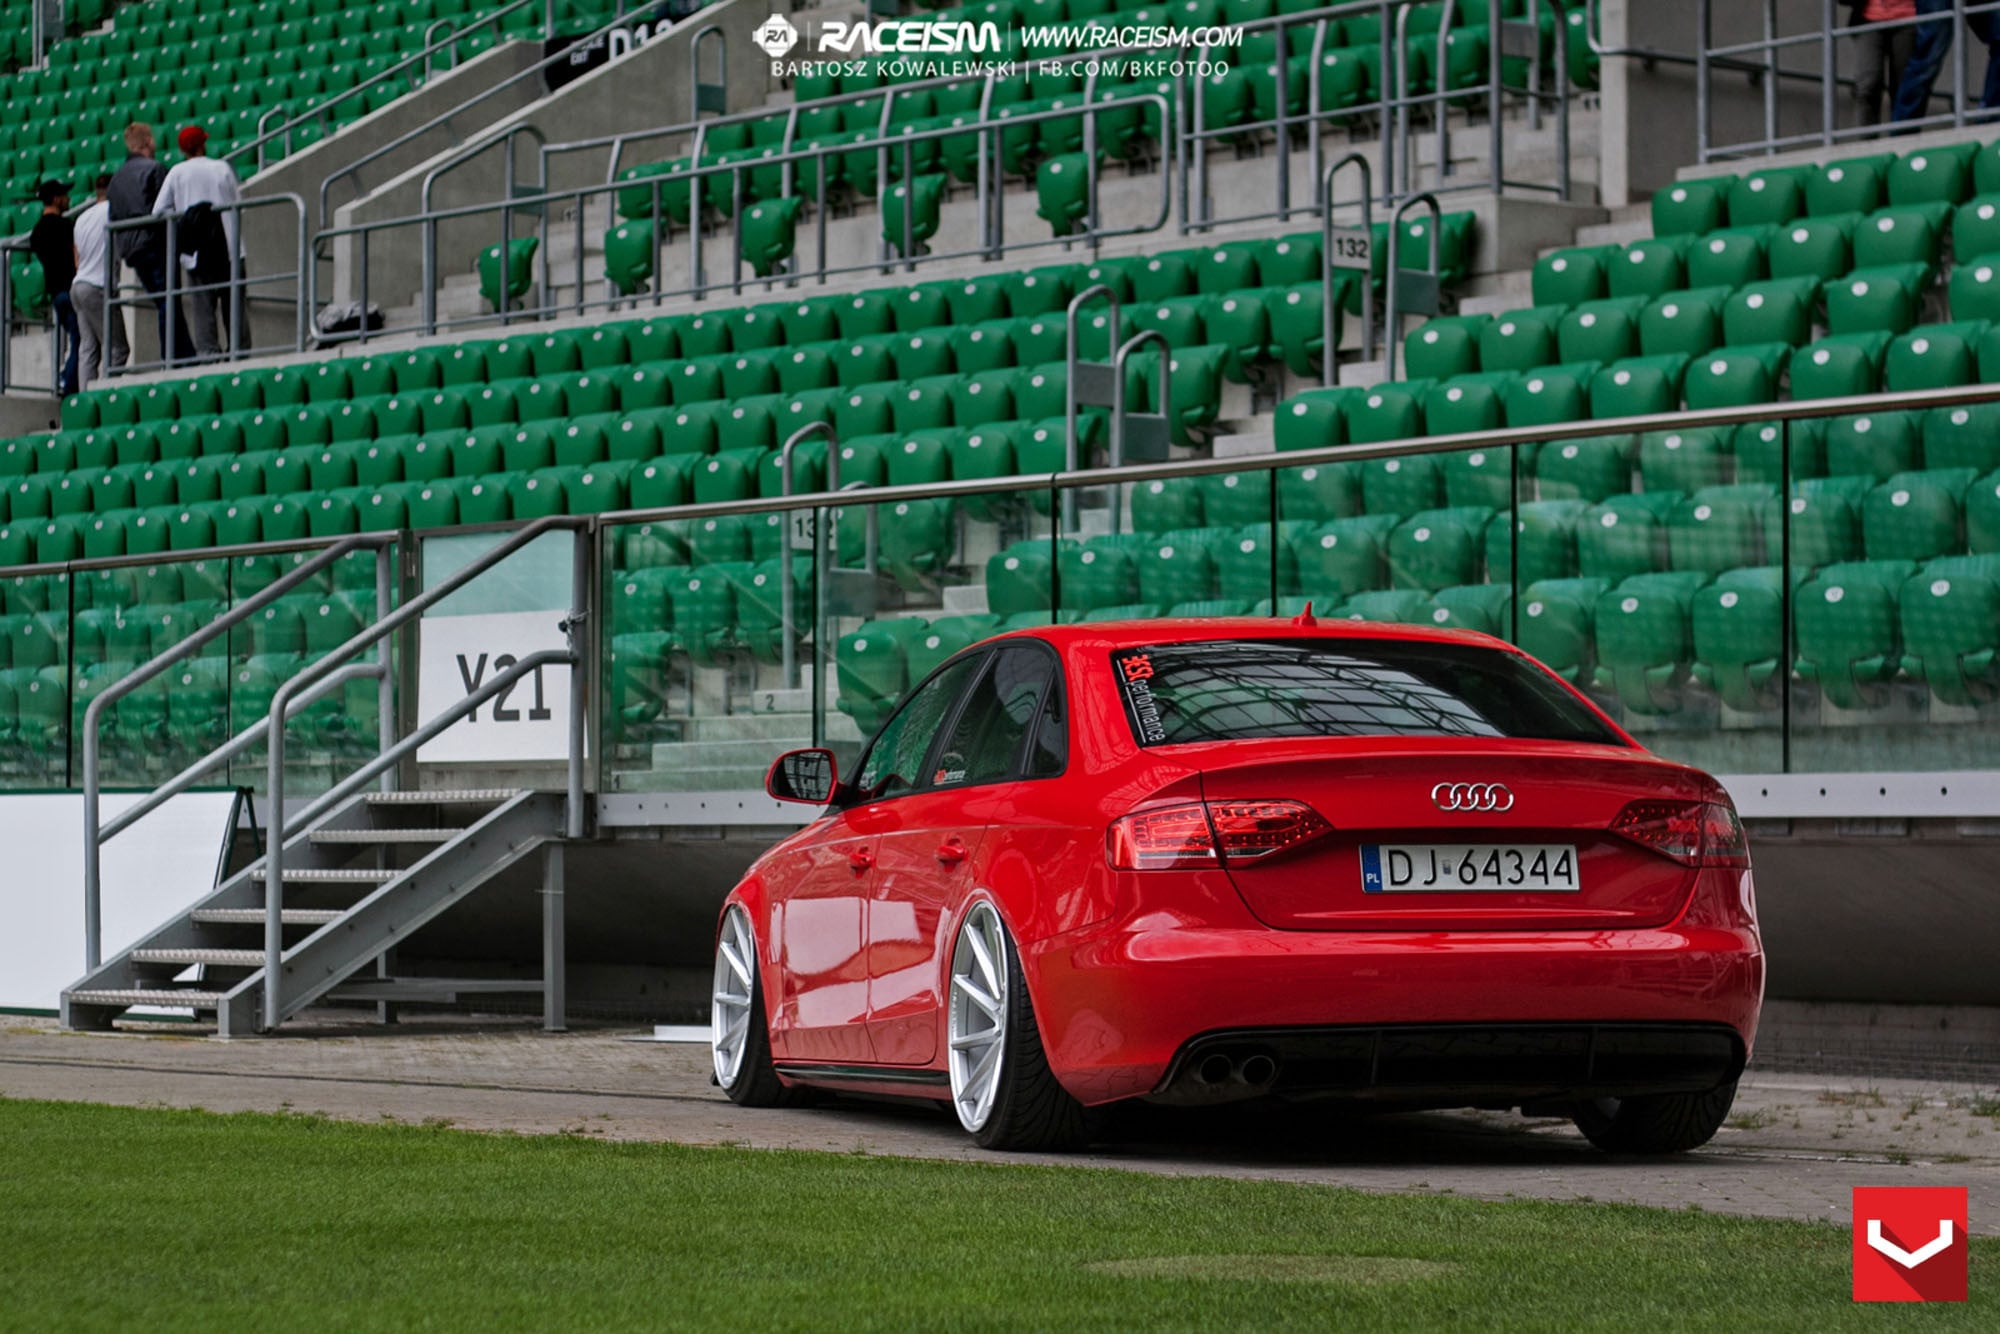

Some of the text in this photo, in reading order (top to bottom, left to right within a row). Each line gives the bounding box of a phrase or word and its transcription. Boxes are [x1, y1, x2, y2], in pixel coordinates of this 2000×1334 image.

[1336, 237, 1368, 258] 132
[456, 653, 551, 722] Y21
[765, 693, 776, 711] 2
[1388, 848, 1573, 886] DJ 64344
[1366, 873, 1380, 883] PL
